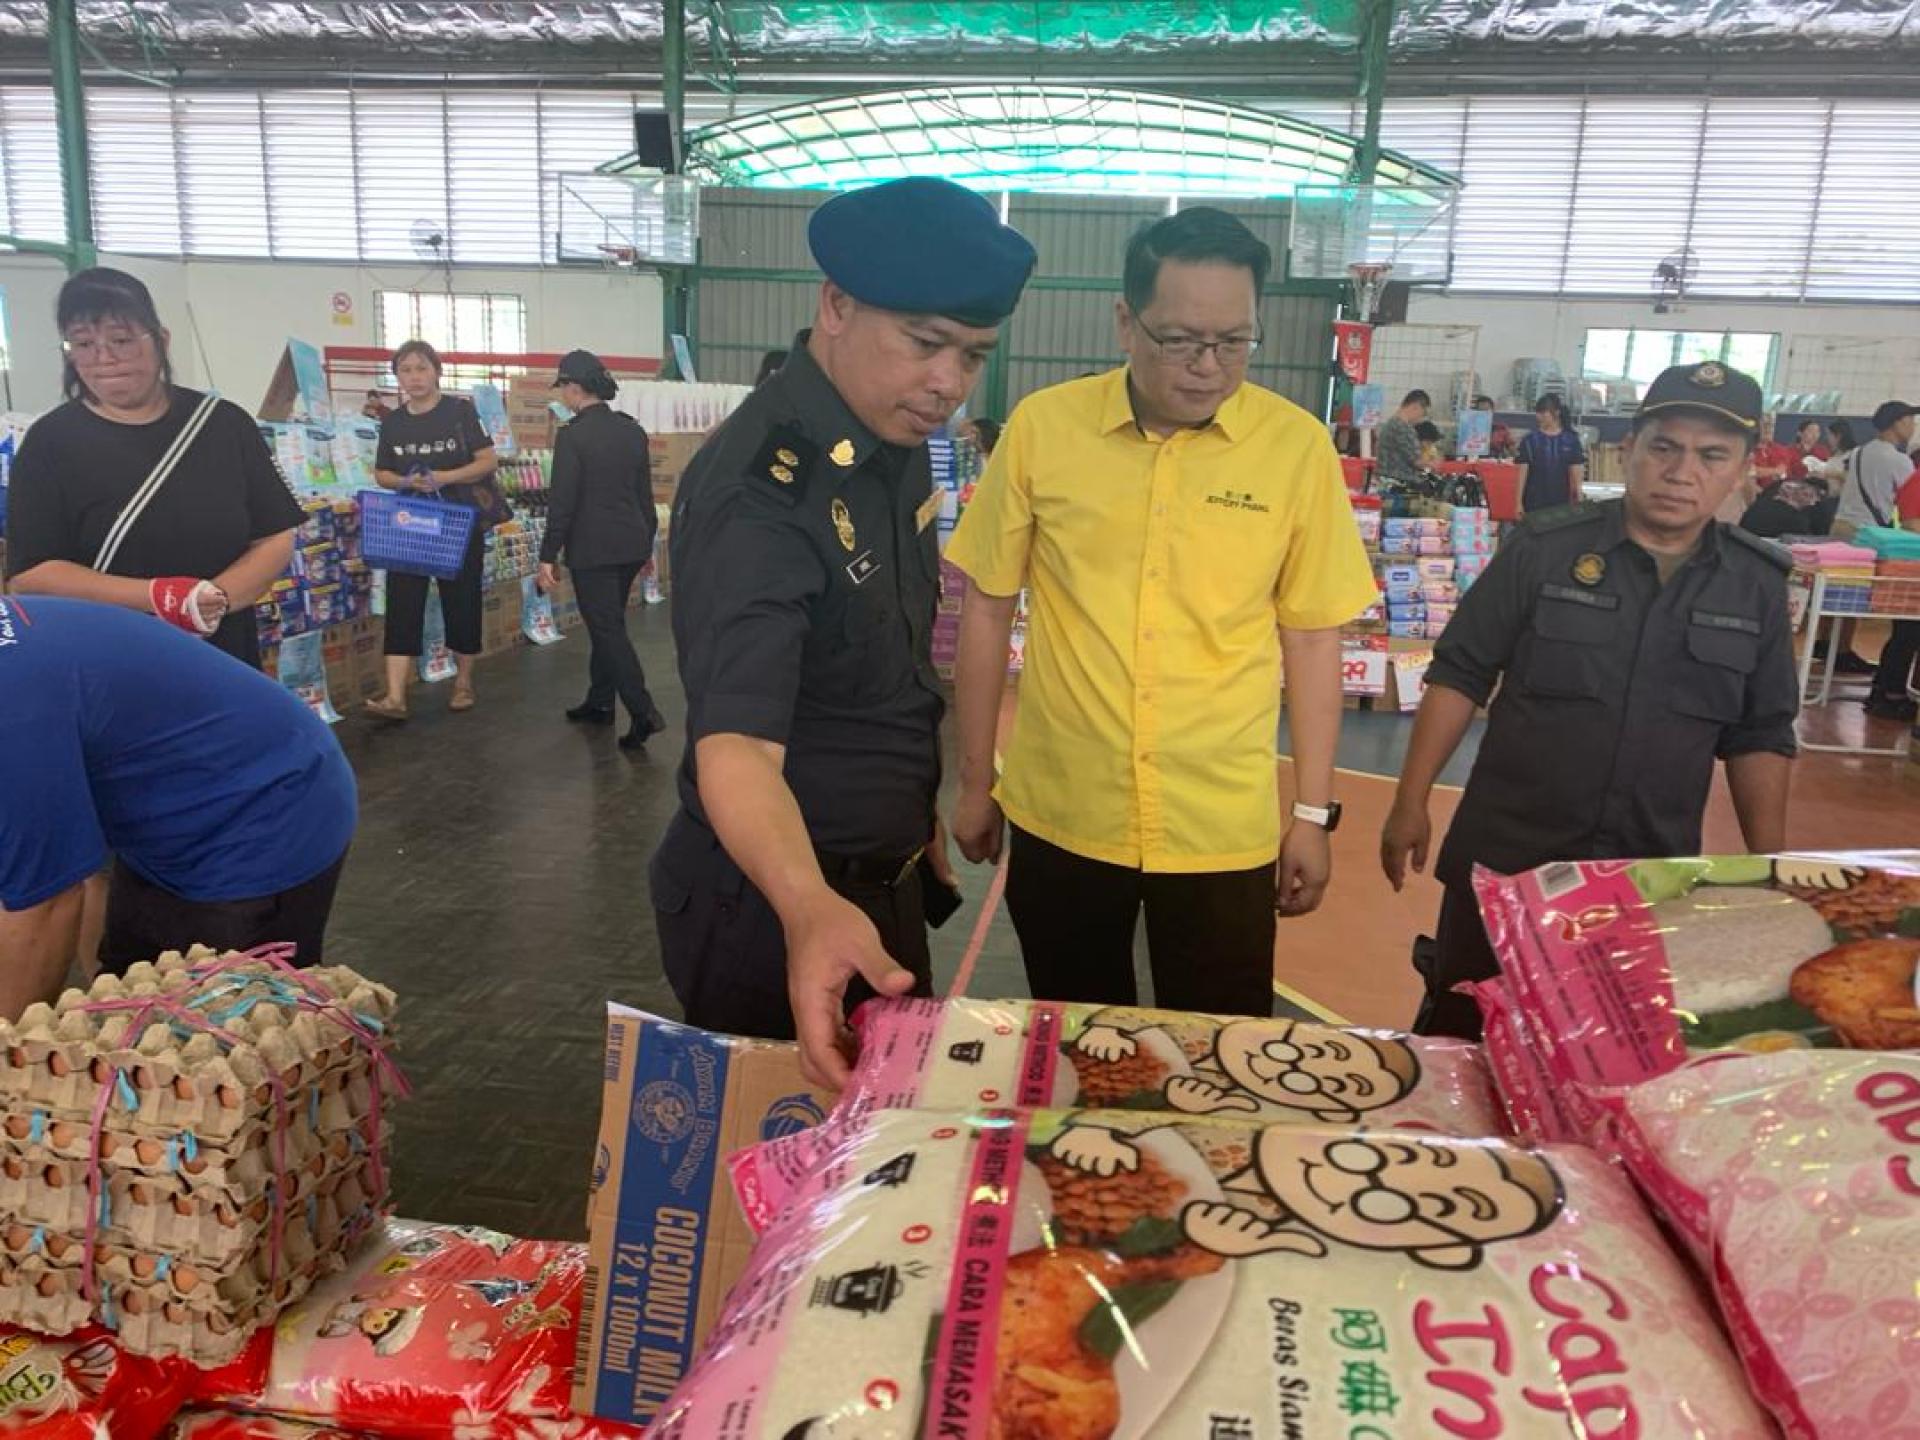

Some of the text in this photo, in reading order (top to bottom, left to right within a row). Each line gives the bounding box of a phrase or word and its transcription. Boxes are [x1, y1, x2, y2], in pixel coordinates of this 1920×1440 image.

[617, 1242, 648, 1271] 12
[642, 1206, 699, 1344] COCONUT
[603, 1295, 641, 1374] 1000ml
[938, 1257, 992, 1440] CARA MEMASAK
[1522, 1261, 1642, 1440] Cap
